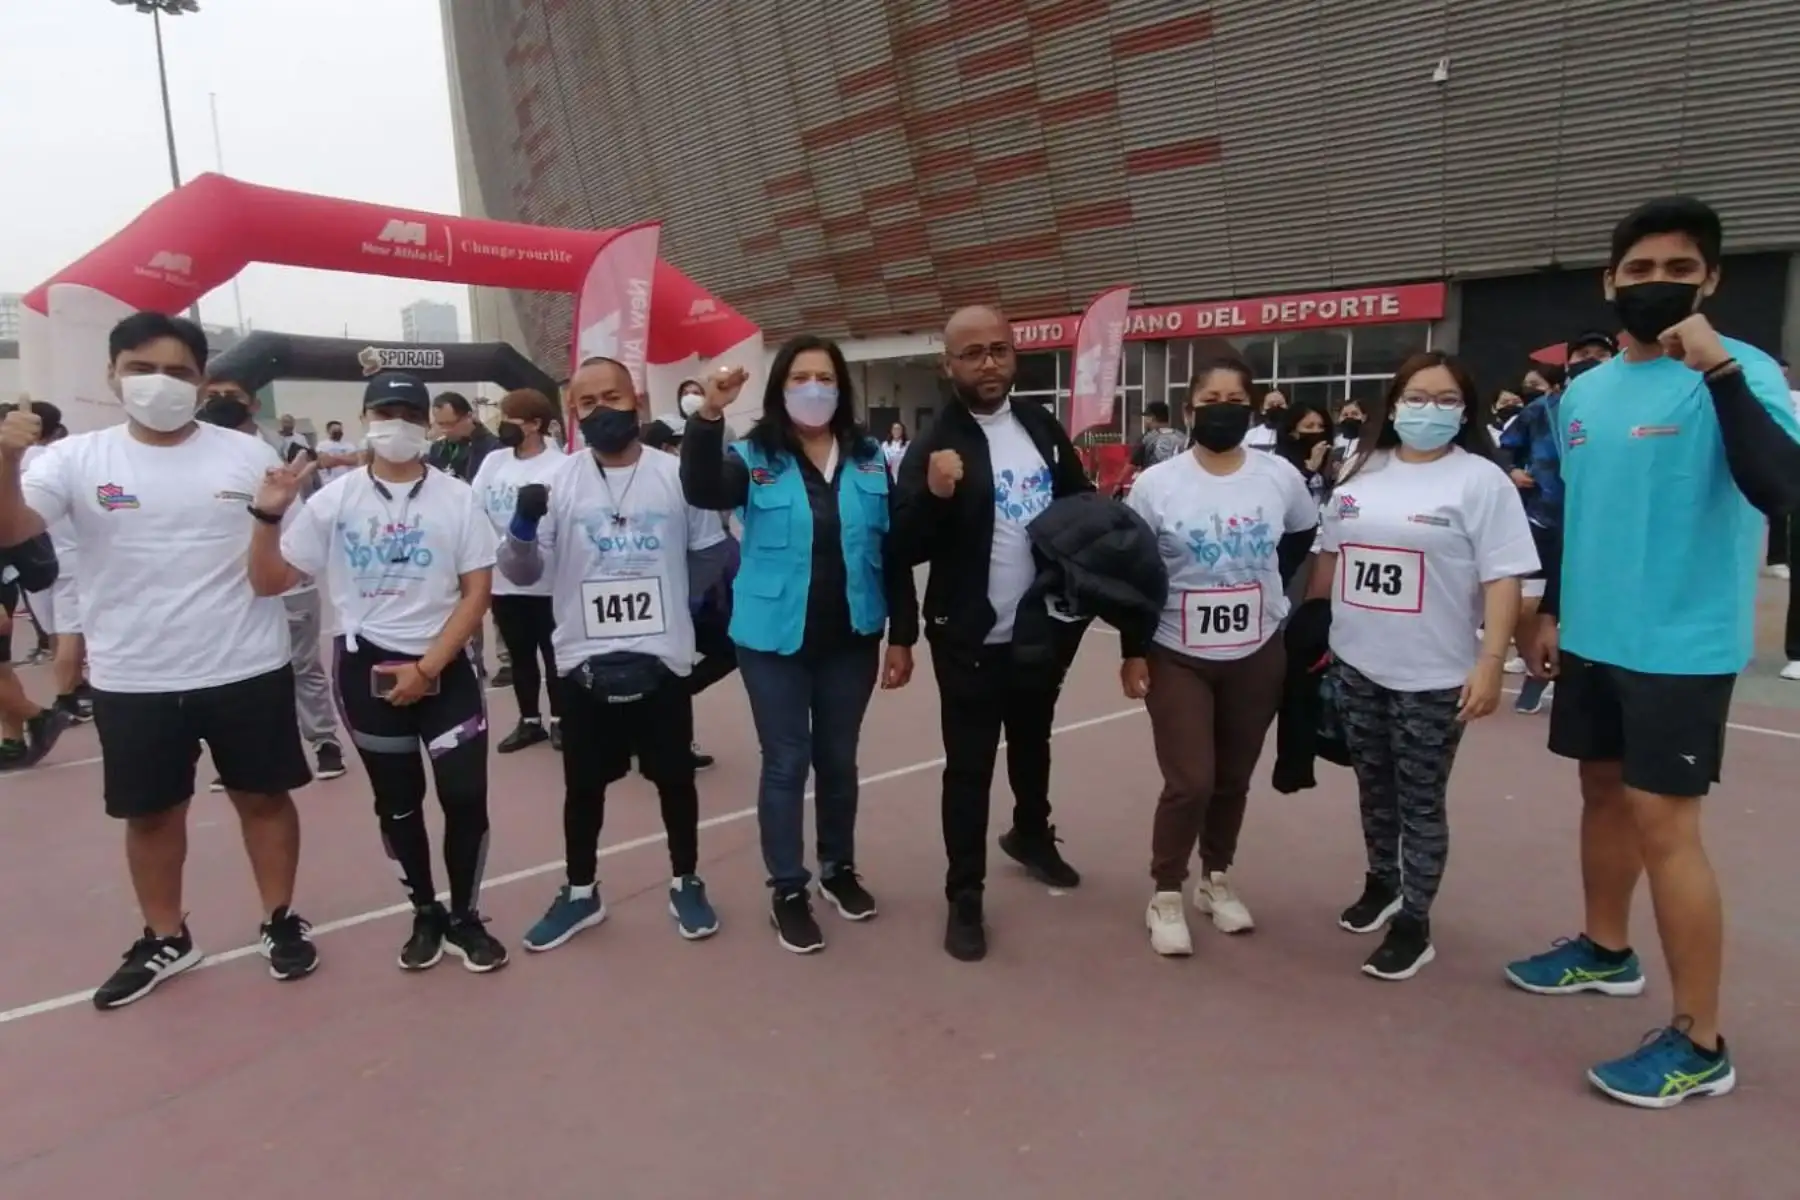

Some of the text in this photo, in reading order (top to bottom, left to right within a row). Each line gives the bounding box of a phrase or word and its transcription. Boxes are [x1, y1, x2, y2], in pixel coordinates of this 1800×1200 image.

[1197, 306, 1246, 330] DEL
[1261, 293, 1400, 325] DEPORTE
[380, 350, 444, 367] SPORADE
[1354, 560, 1403, 596] 743
[592, 591, 653, 624] 1412
[1197, 603, 1250, 634] 769
